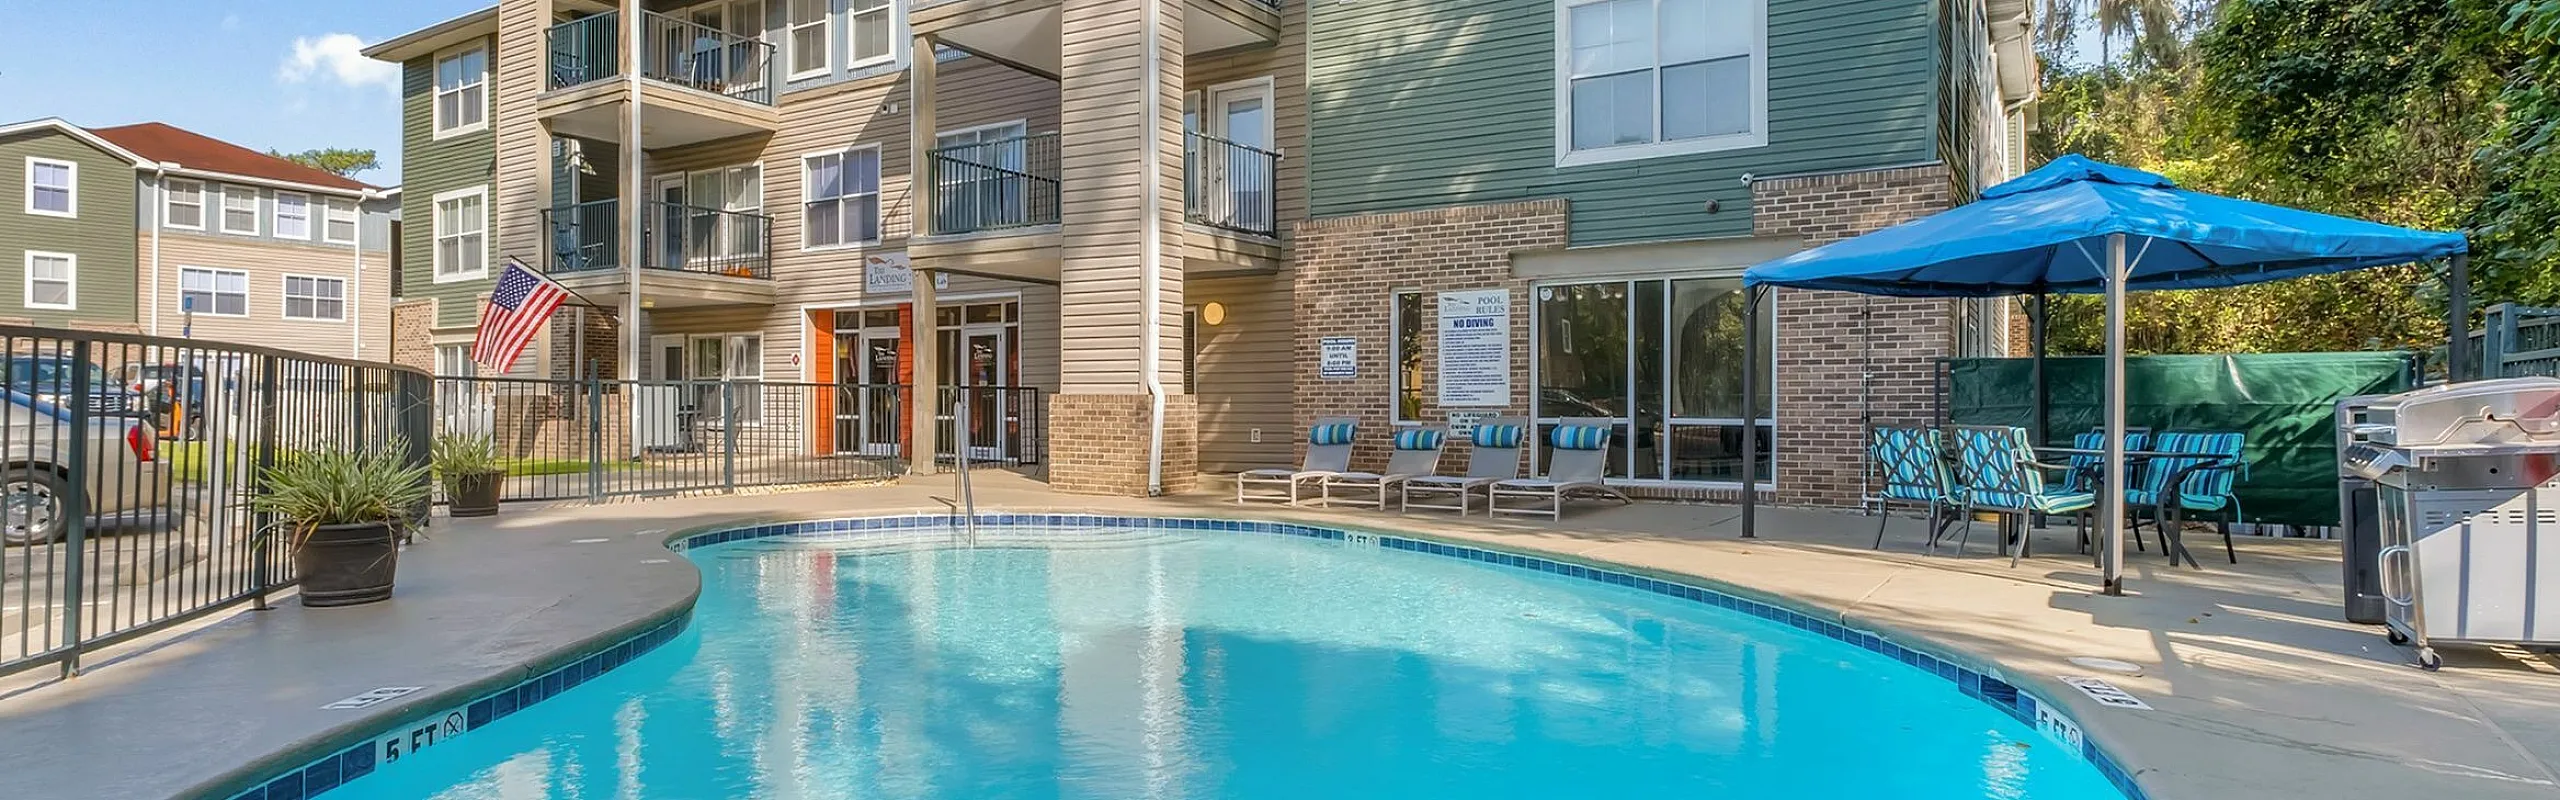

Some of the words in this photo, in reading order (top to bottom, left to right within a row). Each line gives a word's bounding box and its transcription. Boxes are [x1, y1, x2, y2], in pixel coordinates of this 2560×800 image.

[869, 273, 907, 285] LANDING
[1477, 296, 1503, 306] POOL
[1476, 304, 1505, 315] RULES
[1453, 319, 1465, 329] NO
[1466, 317, 1494, 328] DIVING
[386, 738, 400, 764] 5
[411, 723, 437, 755] FT
